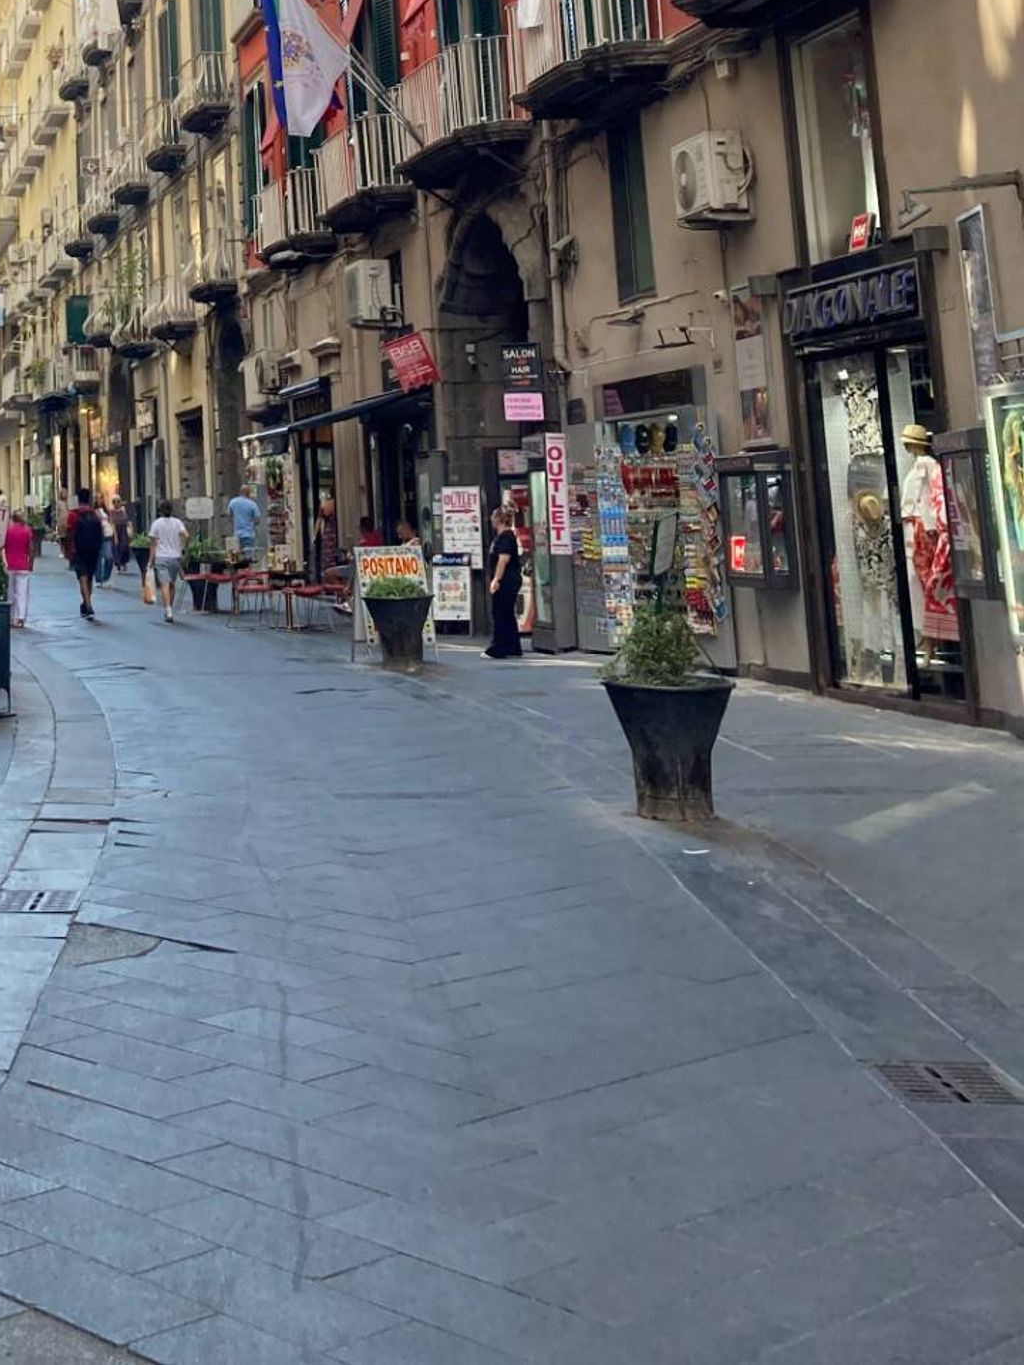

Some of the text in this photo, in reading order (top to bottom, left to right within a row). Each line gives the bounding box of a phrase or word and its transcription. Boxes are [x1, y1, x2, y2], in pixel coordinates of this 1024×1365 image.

[783, 269, 915, 334] DIAGONALE
[502, 349, 536, 360] SALON
[443, 494, 477, 506] OUTLET
[547, 446, 566, 541] OUTLET
[362, 556, 419, 575] POSITANO
